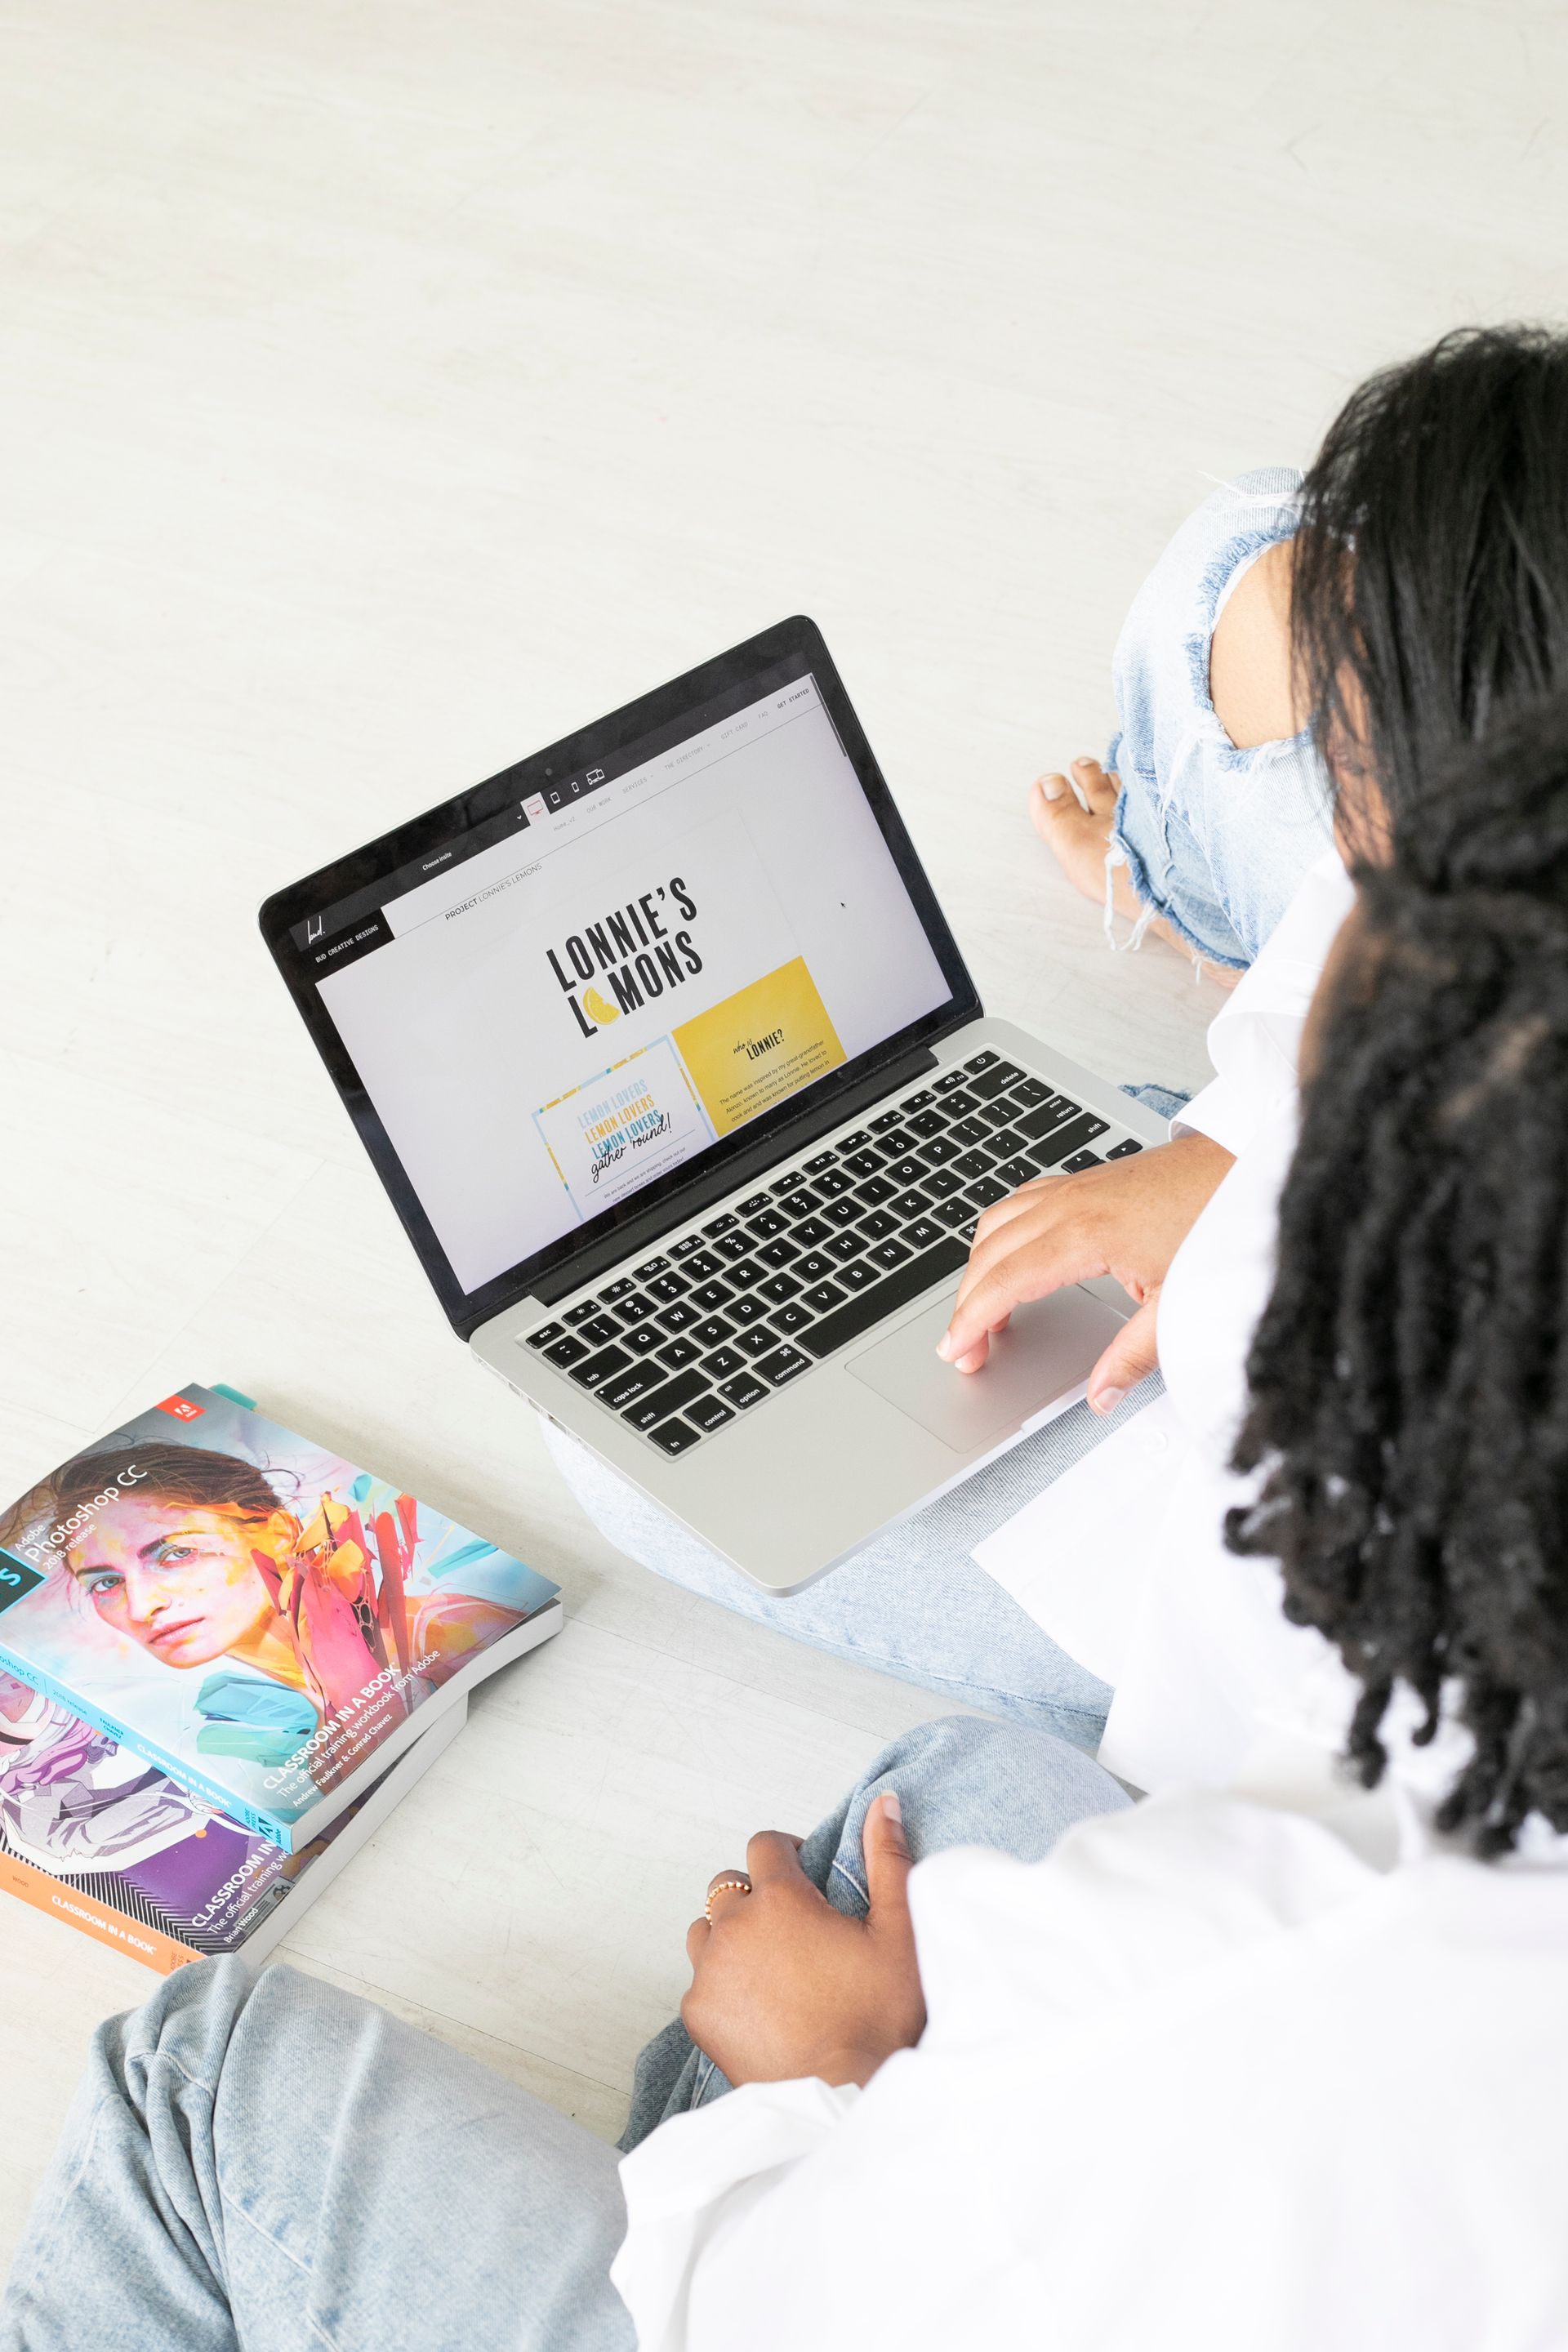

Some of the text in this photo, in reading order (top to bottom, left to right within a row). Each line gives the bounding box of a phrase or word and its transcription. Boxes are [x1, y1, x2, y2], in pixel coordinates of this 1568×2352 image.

[777, 688, 810, 710] GET STARTED
[622, 777, 648, 794] SERVICES
[586, 796, 612, 814] OUR WORK
[422, 859, 440, 871] Choose
[444, 862, 543, 920] PROJECT LONNIE'S LEMONS
[315, 924, 379, 964] BUD CREATIVE DESIGNS
[746, 1028, 785, 1061] LONNIE?
[719, 1097, 730, 1105] The
[729, 1089, 743, 1099] name
[743, 1084, 753, 1092] was
[753, 1071, 772, 1086] inspired
[772, 1067, 778, 1076] by
[777, 1063, 786, 1072] my
[743, 1091, 759, 1103] known
[764, 1080, 778, 1091] many
[800, 1060, 809, 1068] He
[808, 1053, 822, 1064] loved
[1000, 1071, 1019, 1085] delete
[731, 1112, 743, 1122] cook
[743, 1107, 753, 1116] and
[752, 1100, 762, 1110] and
[762, 1096, 773, 1105] was
[772, 1086, 788, 1098] known
[794, 1071, 811, 1085] putting
[809, 1064, 825, 1076] lemon
[577, 1079, 648, 1129] LEMON LOVERS
[1049, 1098, 1062, 1109] enter
[1056, 1106, 1075, 1119] return
[584, 1094, 656, 1145] LEMON LOVERS
[591, 1109, 662, 1160] LEMON LOVERS
[1087, 1123, 1102, 1134] shift
[933, 1146, 942, 1154] P
[591, 1144, 626, 1183] gather
[902, 1165, 913, 1174] O
[904, 1198, 917, 1208] K
[837, 1206, 849, 1214] U
[804, 1227, 815, 1235] Y
[915, 1227, 930, 1237] M
[840, 1240, 853, 1250] H
[772, 1248, 782, 1256] T
[883, 1248, 896, 1258] N
[808, 1261, 819, 1270] G
[739, 1269, 751, 1278] R
[851, 1270, 862, 1279] B
[774, 1283, 783, 1292] F
[706, 1290, 717, 1299] E
[817, 1290, 828, 1299] V
[740, 1304, 752, 1313] D
[670, 1311, 684, 1321] W
[785, 1312, 797, 1321] C
[539, 1330, 551, 1339] esc
[707, 1326, 718, 1335] S
[638, 1334, 651, 1343] Q
[751, 1334, 764, 1345] X
[674, 1348, 686, 1357] A
[716, 1356, 729, 1366] Z
[774, 1358, 804, 1380] command
[586, 1373, 599, 1383] tab
[612, 1383, 644, 1403] caps lock
[739, 1388, 760, 1404] option
[640, 1412, 656, 1424] shift
[704, 1409, 727, 1427] control
[24, 1464, 148, 1563] Photoshop CC
[15, 1524, 46, 1552] Adobe
[42, 1522, 98, 1570] 2018 release
[26, 1672, 39, 1686] CC
[276, 1650, 441, 1797] The official training workbook from Adobe
[262, 1719, 341, 1790] CLASSROOM
[335, 1705, 355, 1722] IN
[351, 1696, 367, 1709] A
[292, 1713, 393, 1807] Andrew Faulkner & Conrad Chavez
[136, 1744, 188, 1781] CLASSROOM
[187, 1775, 198, 1787] IN
[197, 1782, 205, 1792] A
[12, 1875, 29, 1888] WOOD
[191, 1838, 277, 1928] CLASSROOM IN
[207, 1917, 228, 1935] The
[226, 1890, 253, 1919] official
[247, 1861, 283, 1893] training
[51, 1895, 106, 1930] CLASSROOM
[108, 1924, 118, 1936] IN
[118, 1930, 127, 1940] A
[223, 1907, 259, 1944] Brian Wood
